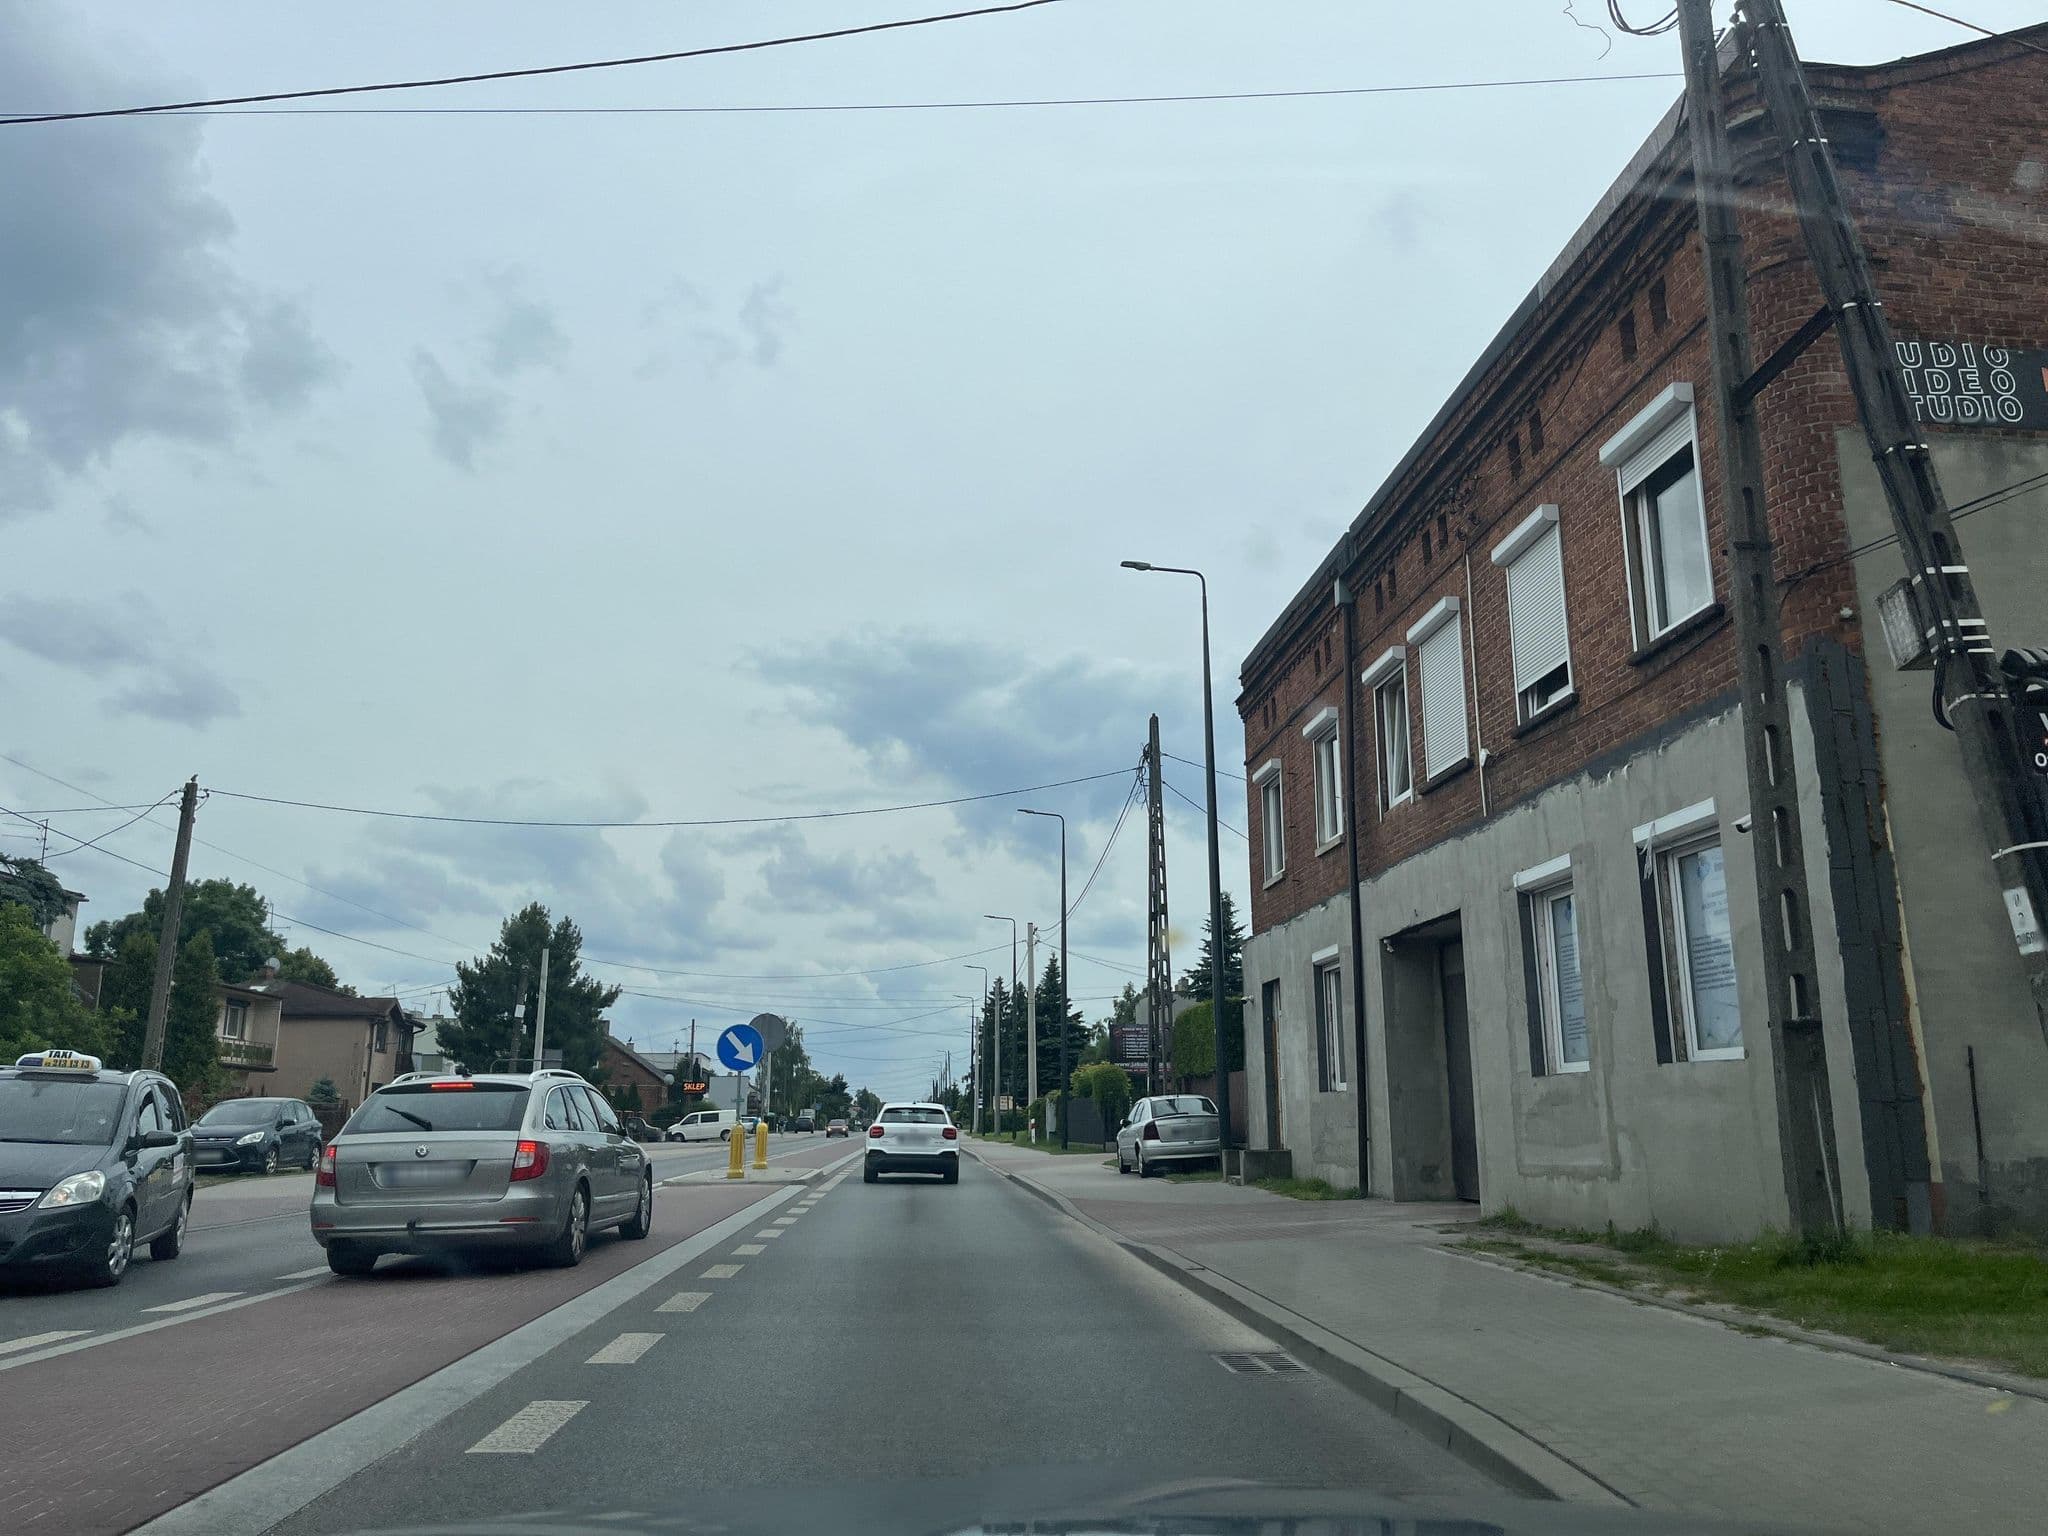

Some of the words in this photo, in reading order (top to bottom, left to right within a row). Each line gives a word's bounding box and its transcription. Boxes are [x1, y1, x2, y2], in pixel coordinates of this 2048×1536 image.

[1895, 341, 2009, 368] UDIO
[1902, 368, 2016, 395] IDEO
[1909, 395, 2024, 422] TUDIO
[48, 1050, 73, 1059] TAXI
[683, 1082, 706, 1091] SKLEP
